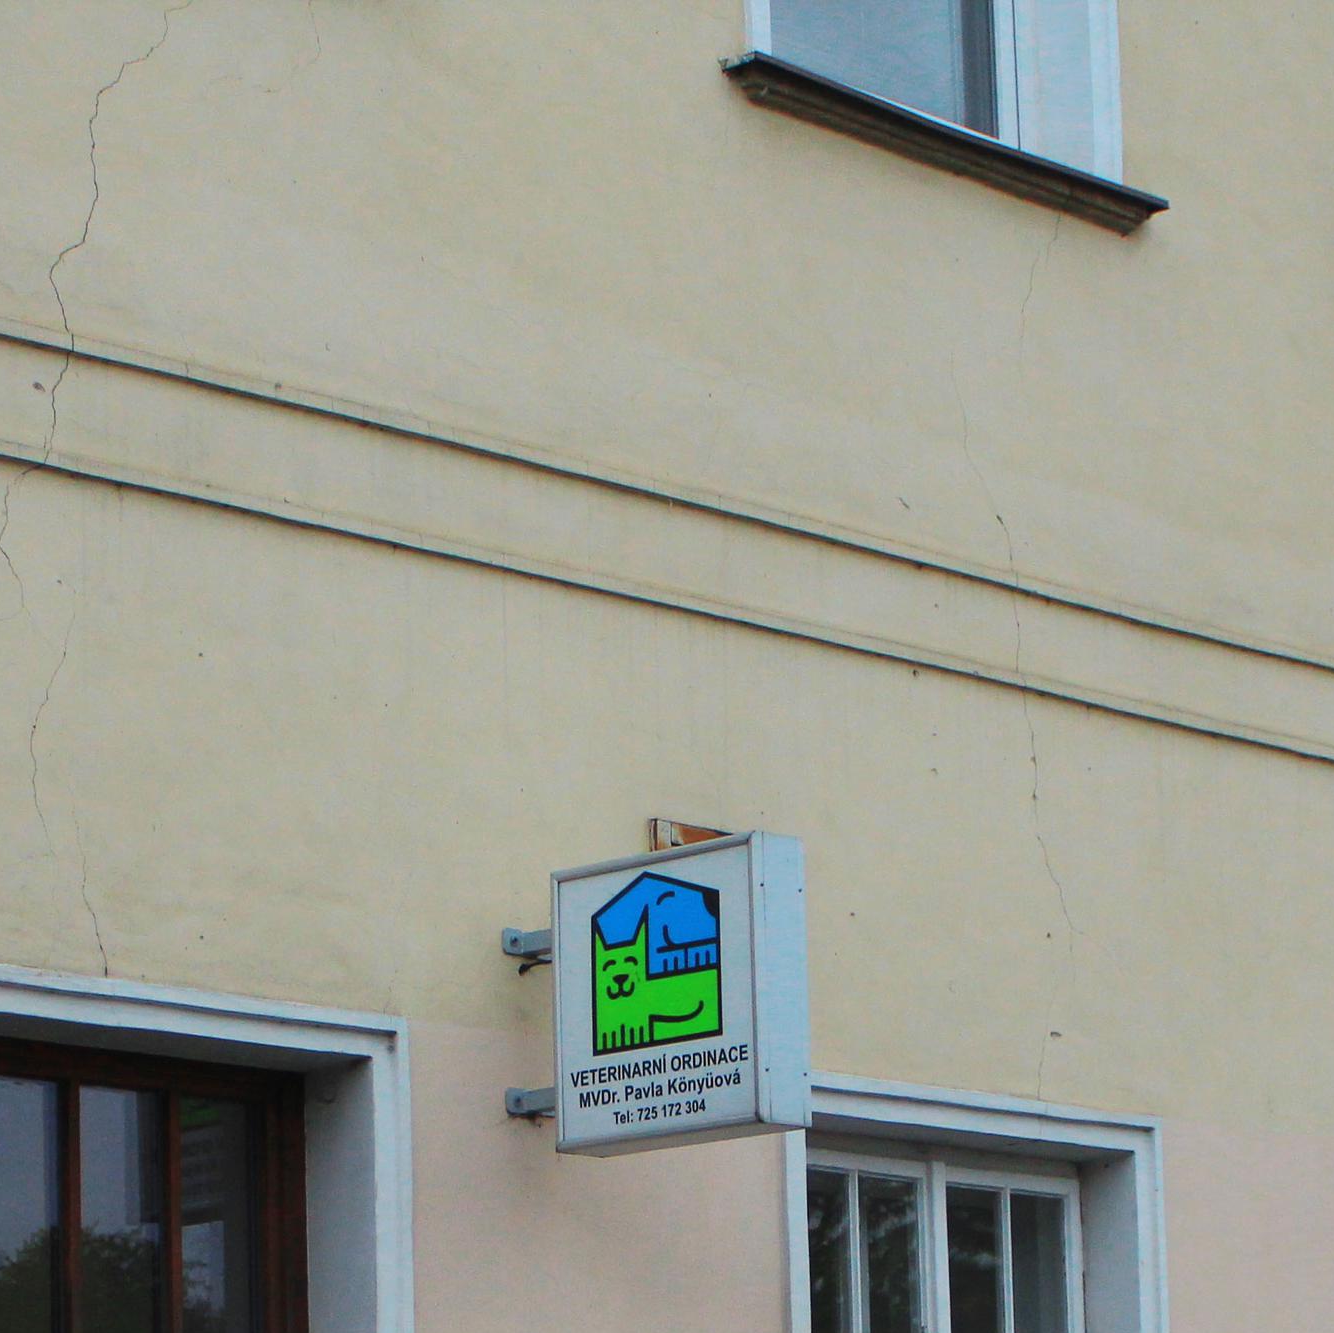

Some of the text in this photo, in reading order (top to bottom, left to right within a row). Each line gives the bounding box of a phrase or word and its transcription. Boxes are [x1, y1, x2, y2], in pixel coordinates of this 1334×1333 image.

[670, 1044, 749, 1072] ORDINACE
[579, 1068, 741, 1109] MVDr. Pavla Könyüová
[613, 1098, 707, 1125] Tel: 725 172 304
